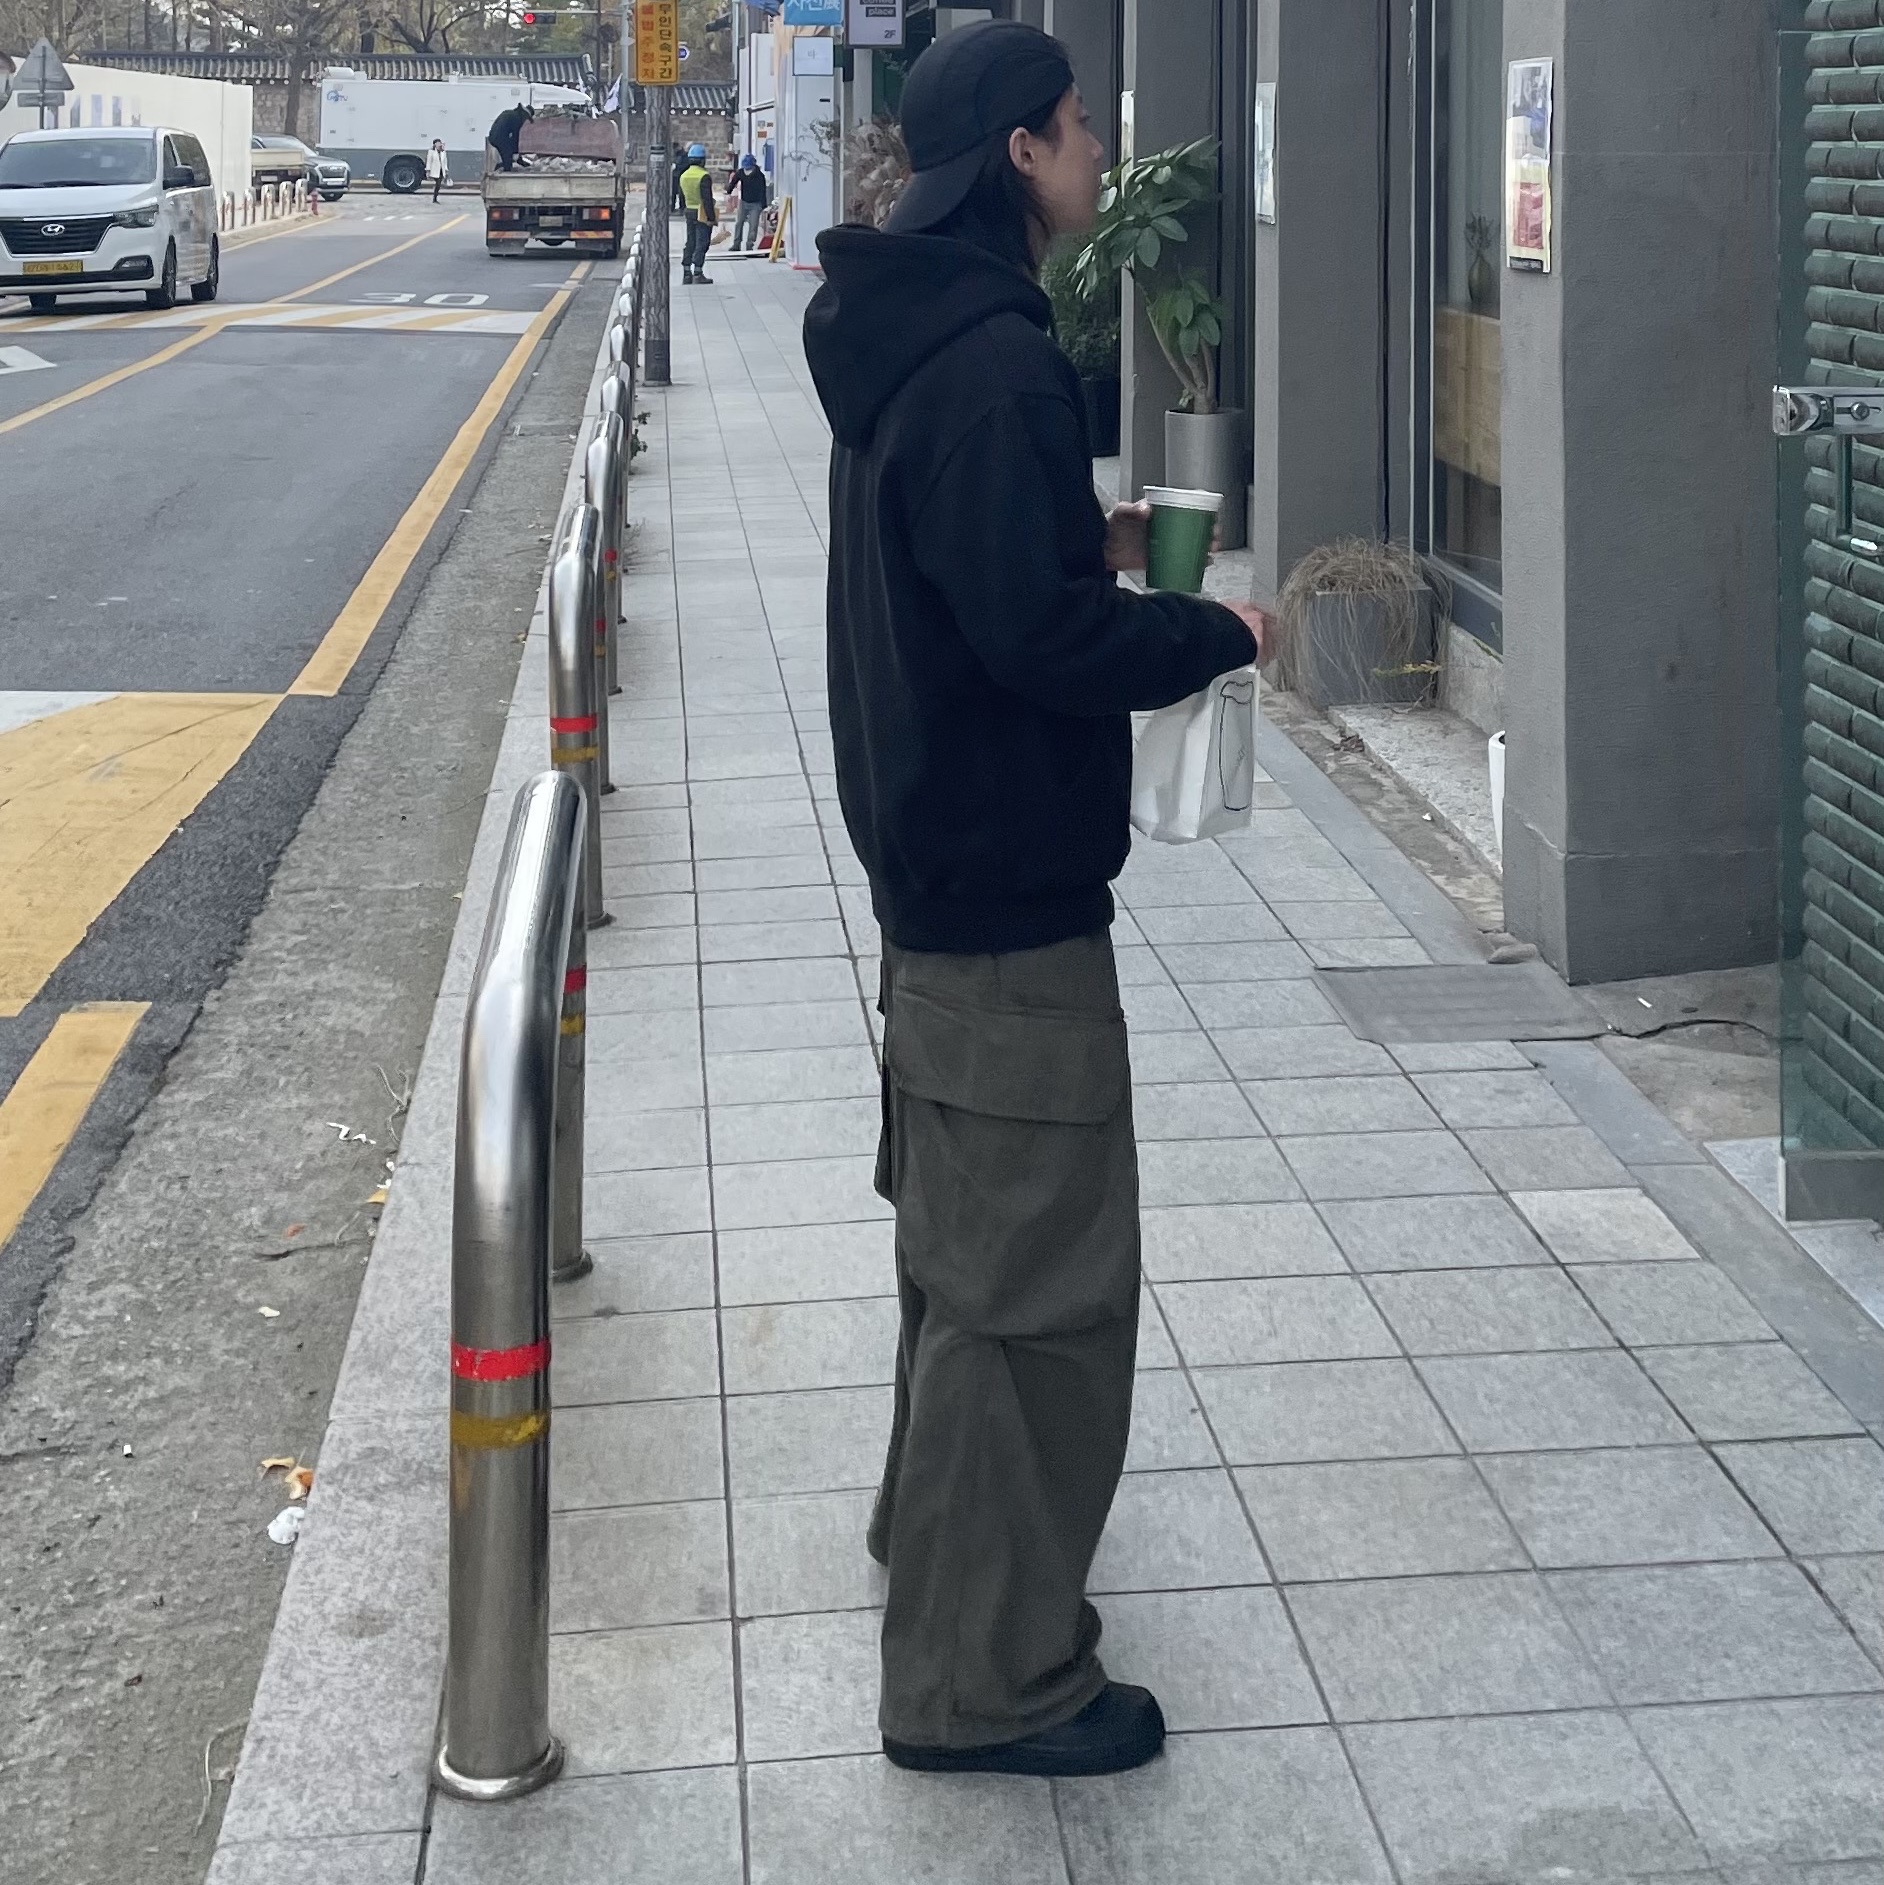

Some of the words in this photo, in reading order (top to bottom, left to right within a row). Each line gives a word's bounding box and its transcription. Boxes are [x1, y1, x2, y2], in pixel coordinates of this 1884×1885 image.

[868, 7, 895, 17] place
[884, 29, 897, 39] 2F
[659, 3, 673, 79] 무인단속구간
[347, 292, 490, 306] 30
